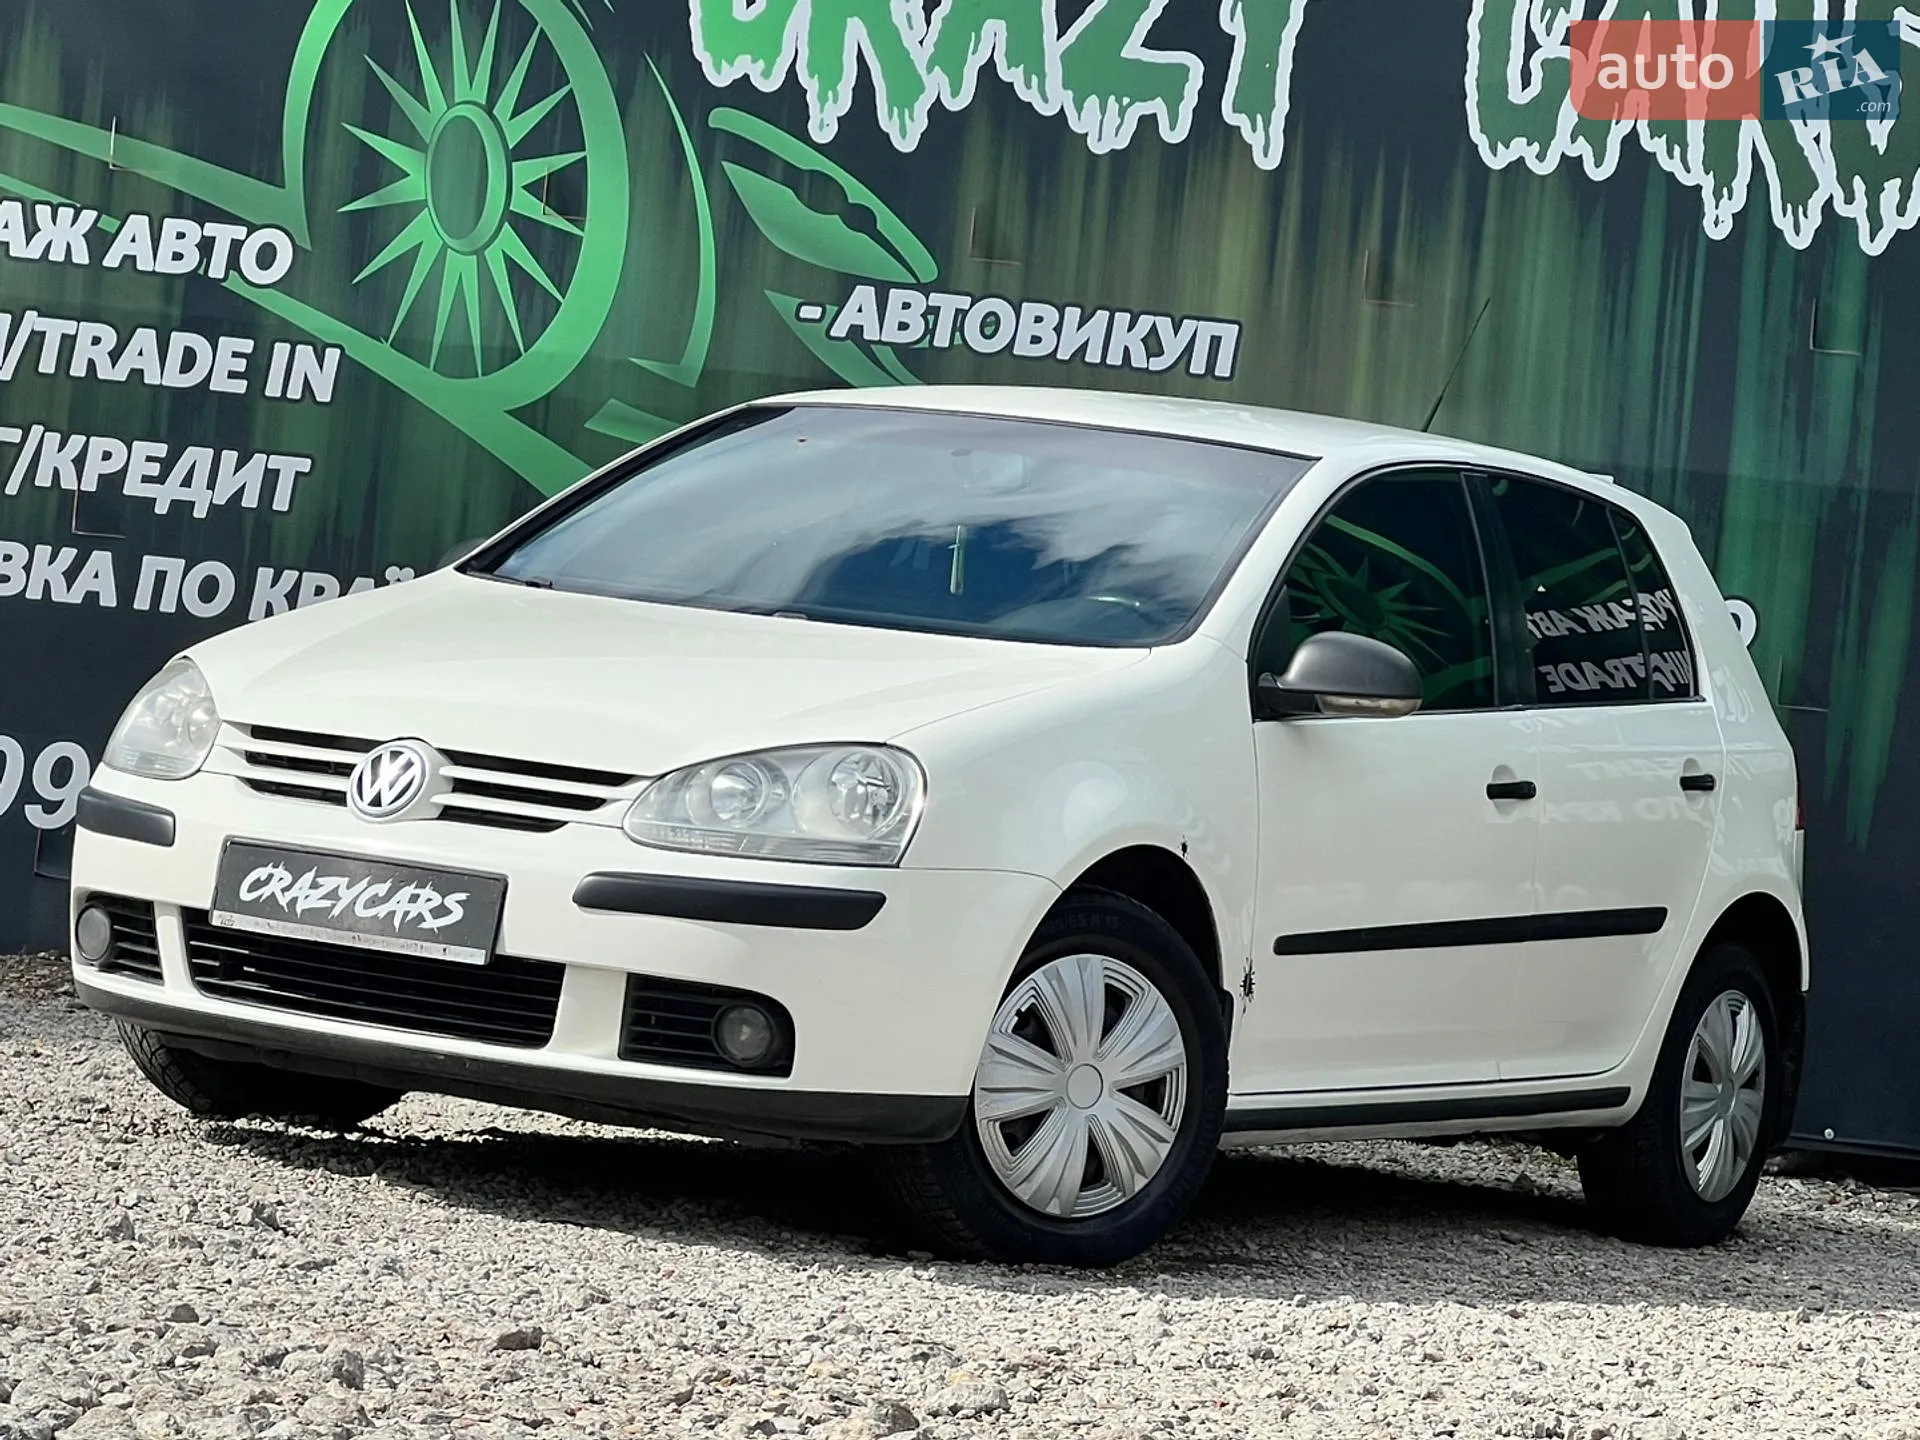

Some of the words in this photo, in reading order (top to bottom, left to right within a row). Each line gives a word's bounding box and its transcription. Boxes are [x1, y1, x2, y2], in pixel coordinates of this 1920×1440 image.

[103, 214, 293, 285] АВТО
[830, 285, 1239, 378] АВТОВИКУП
[265, 342, 340, 402] IN
[0, 541, 117, 608] ВКА
[133, 555, 236, 619] ПО
[239, 862, 470, 934] CRAZYCARS
